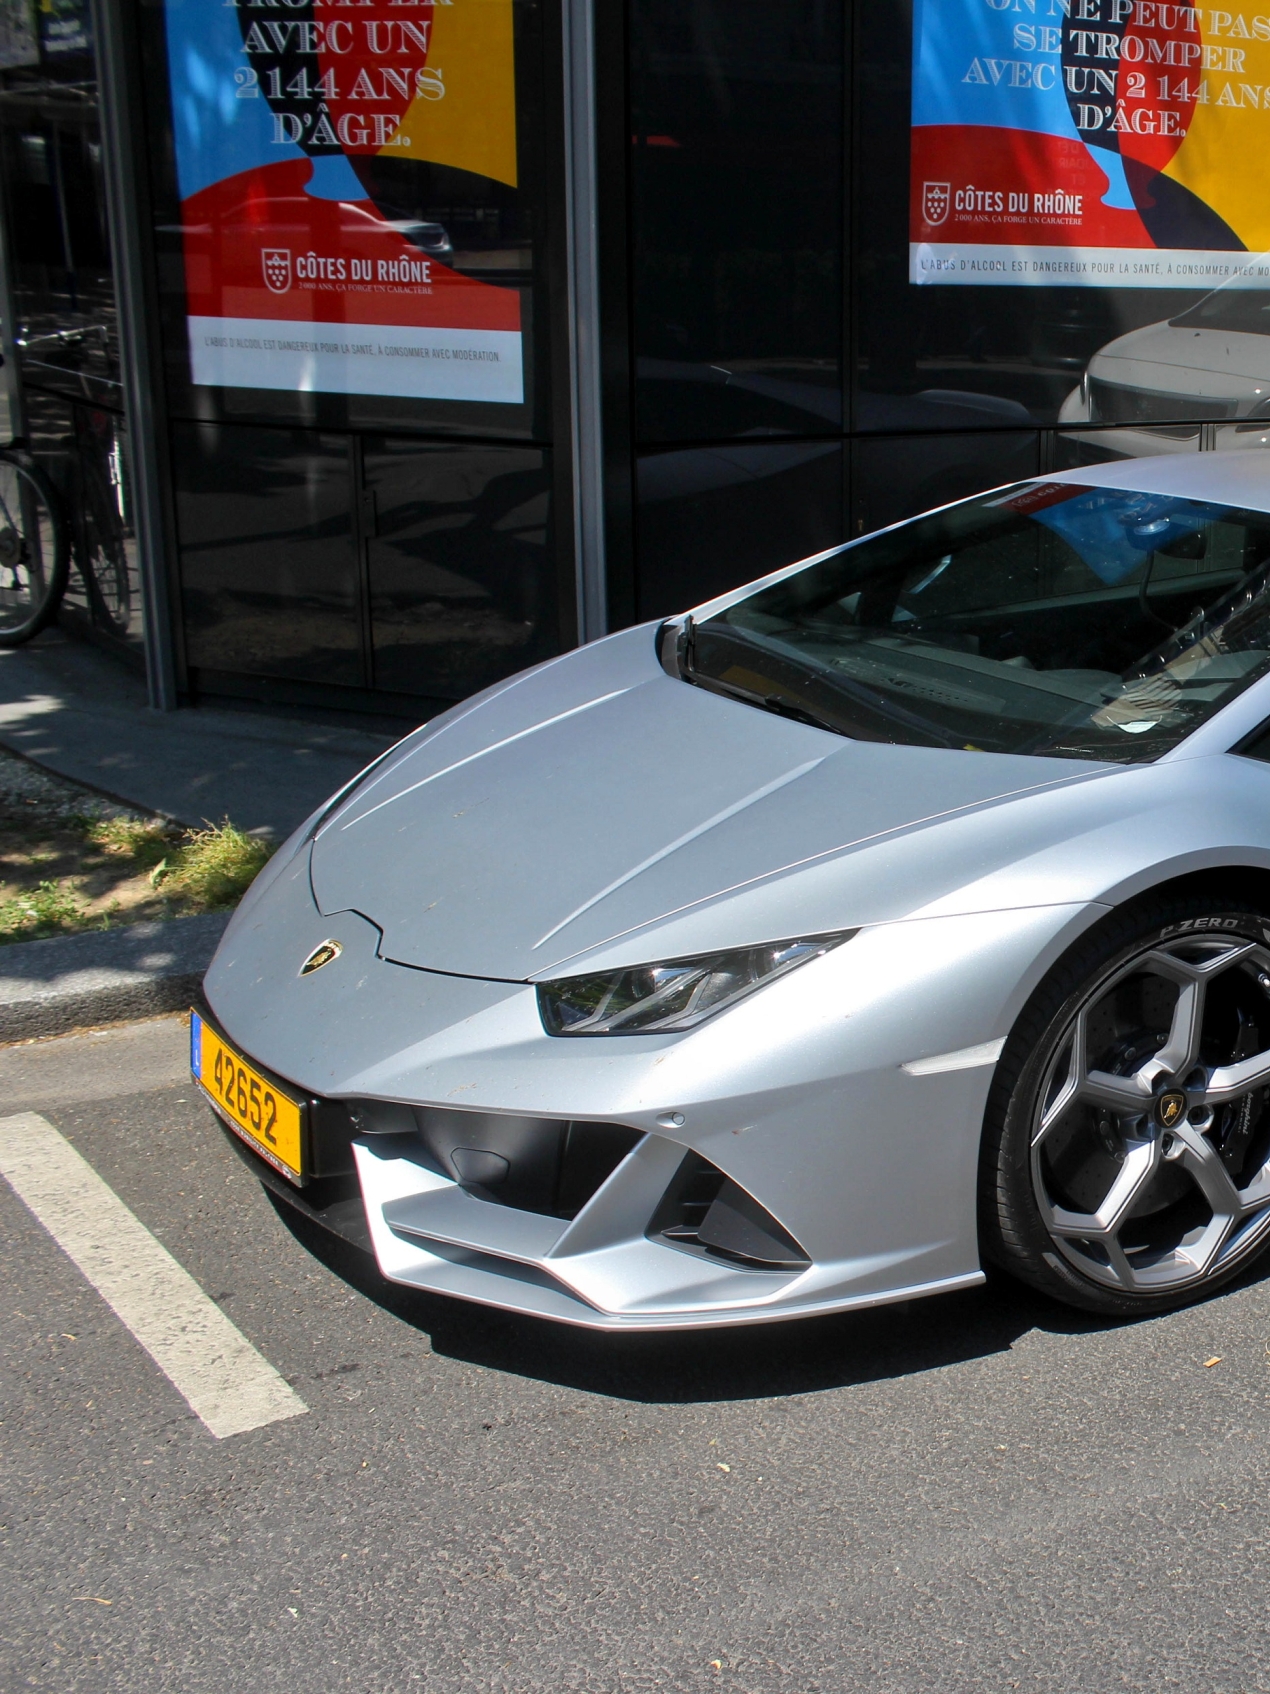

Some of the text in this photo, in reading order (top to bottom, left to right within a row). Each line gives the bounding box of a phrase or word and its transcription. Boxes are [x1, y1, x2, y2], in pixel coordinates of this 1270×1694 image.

[1047, 0, 1100, 21] NE
[1108, 0, 1203, 33] PEUT
[240, 20, 431, 53] AVEC UN
[1013, 23, 1246, 73] SE TROMPER
[347, 67, 446, 101] ANS
[961, 56, 1056, 91] AVEC
[1063, 65, 1119, 97] UN
[955, 184, 1083, 215] CÔTES DU RHÔNE
[973, 215, 991, 223] ANS,
[992, 215, 1002, 224] ÇA
[1003, 215, 1027, 223] FORGE
[1029, 216, 1040, 224] UN
[1041, 216, 1082, 226] CARACTÈRE
[296, 251, 432, 283] CÔTES DU RHÔNE
[1012, 261, 1028, 272] EST
[1033, 261, 1087, 273] DANGEREUX
[1091, 262, 1115, 273] POUR
[1119, 263, 1129, 274] LA
[1133, 262, 1163, 275] SANTÉ,
[1176, 264, 1229, 276] CONSOMMER
[1233, 265, 1254, 276] AVEC
[348, 284, 372, 292] FORGE
[264, 340, 276, 350] EST
[278, 340, 320, 352] DANGEREUX
[320, 343, 339, 353] POUR
[340, 344, 350, 354] LA
[384, 345, 430, 358] CONSOMMER
[432, 348, 450, 360] AVEC
[1160, 917, 1238, 938] P ZERO
[214, 1047, 277, 1147] 42652
